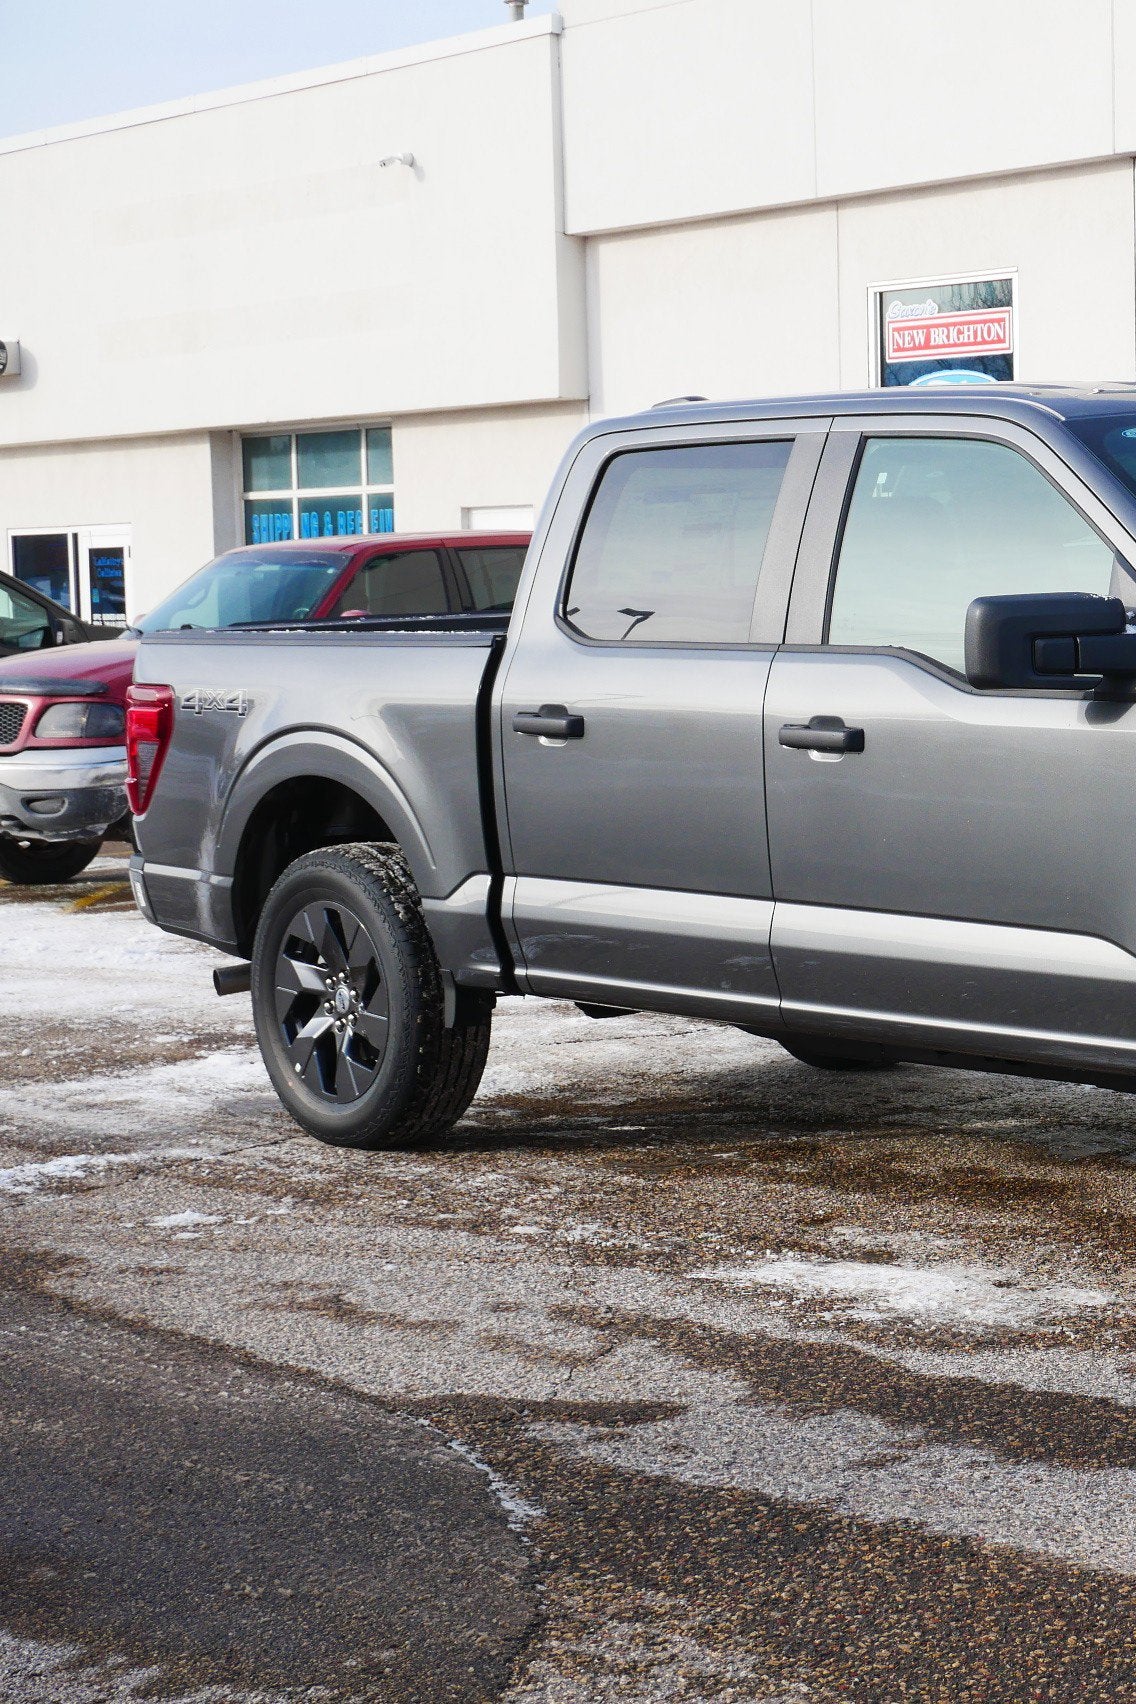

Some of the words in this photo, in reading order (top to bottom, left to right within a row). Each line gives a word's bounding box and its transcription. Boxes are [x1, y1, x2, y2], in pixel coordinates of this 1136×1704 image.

[892, 328, 926, 348] NEW
[929, 321, 1005, 346] BRIGHTON
[323, 511, 333, 537] &
